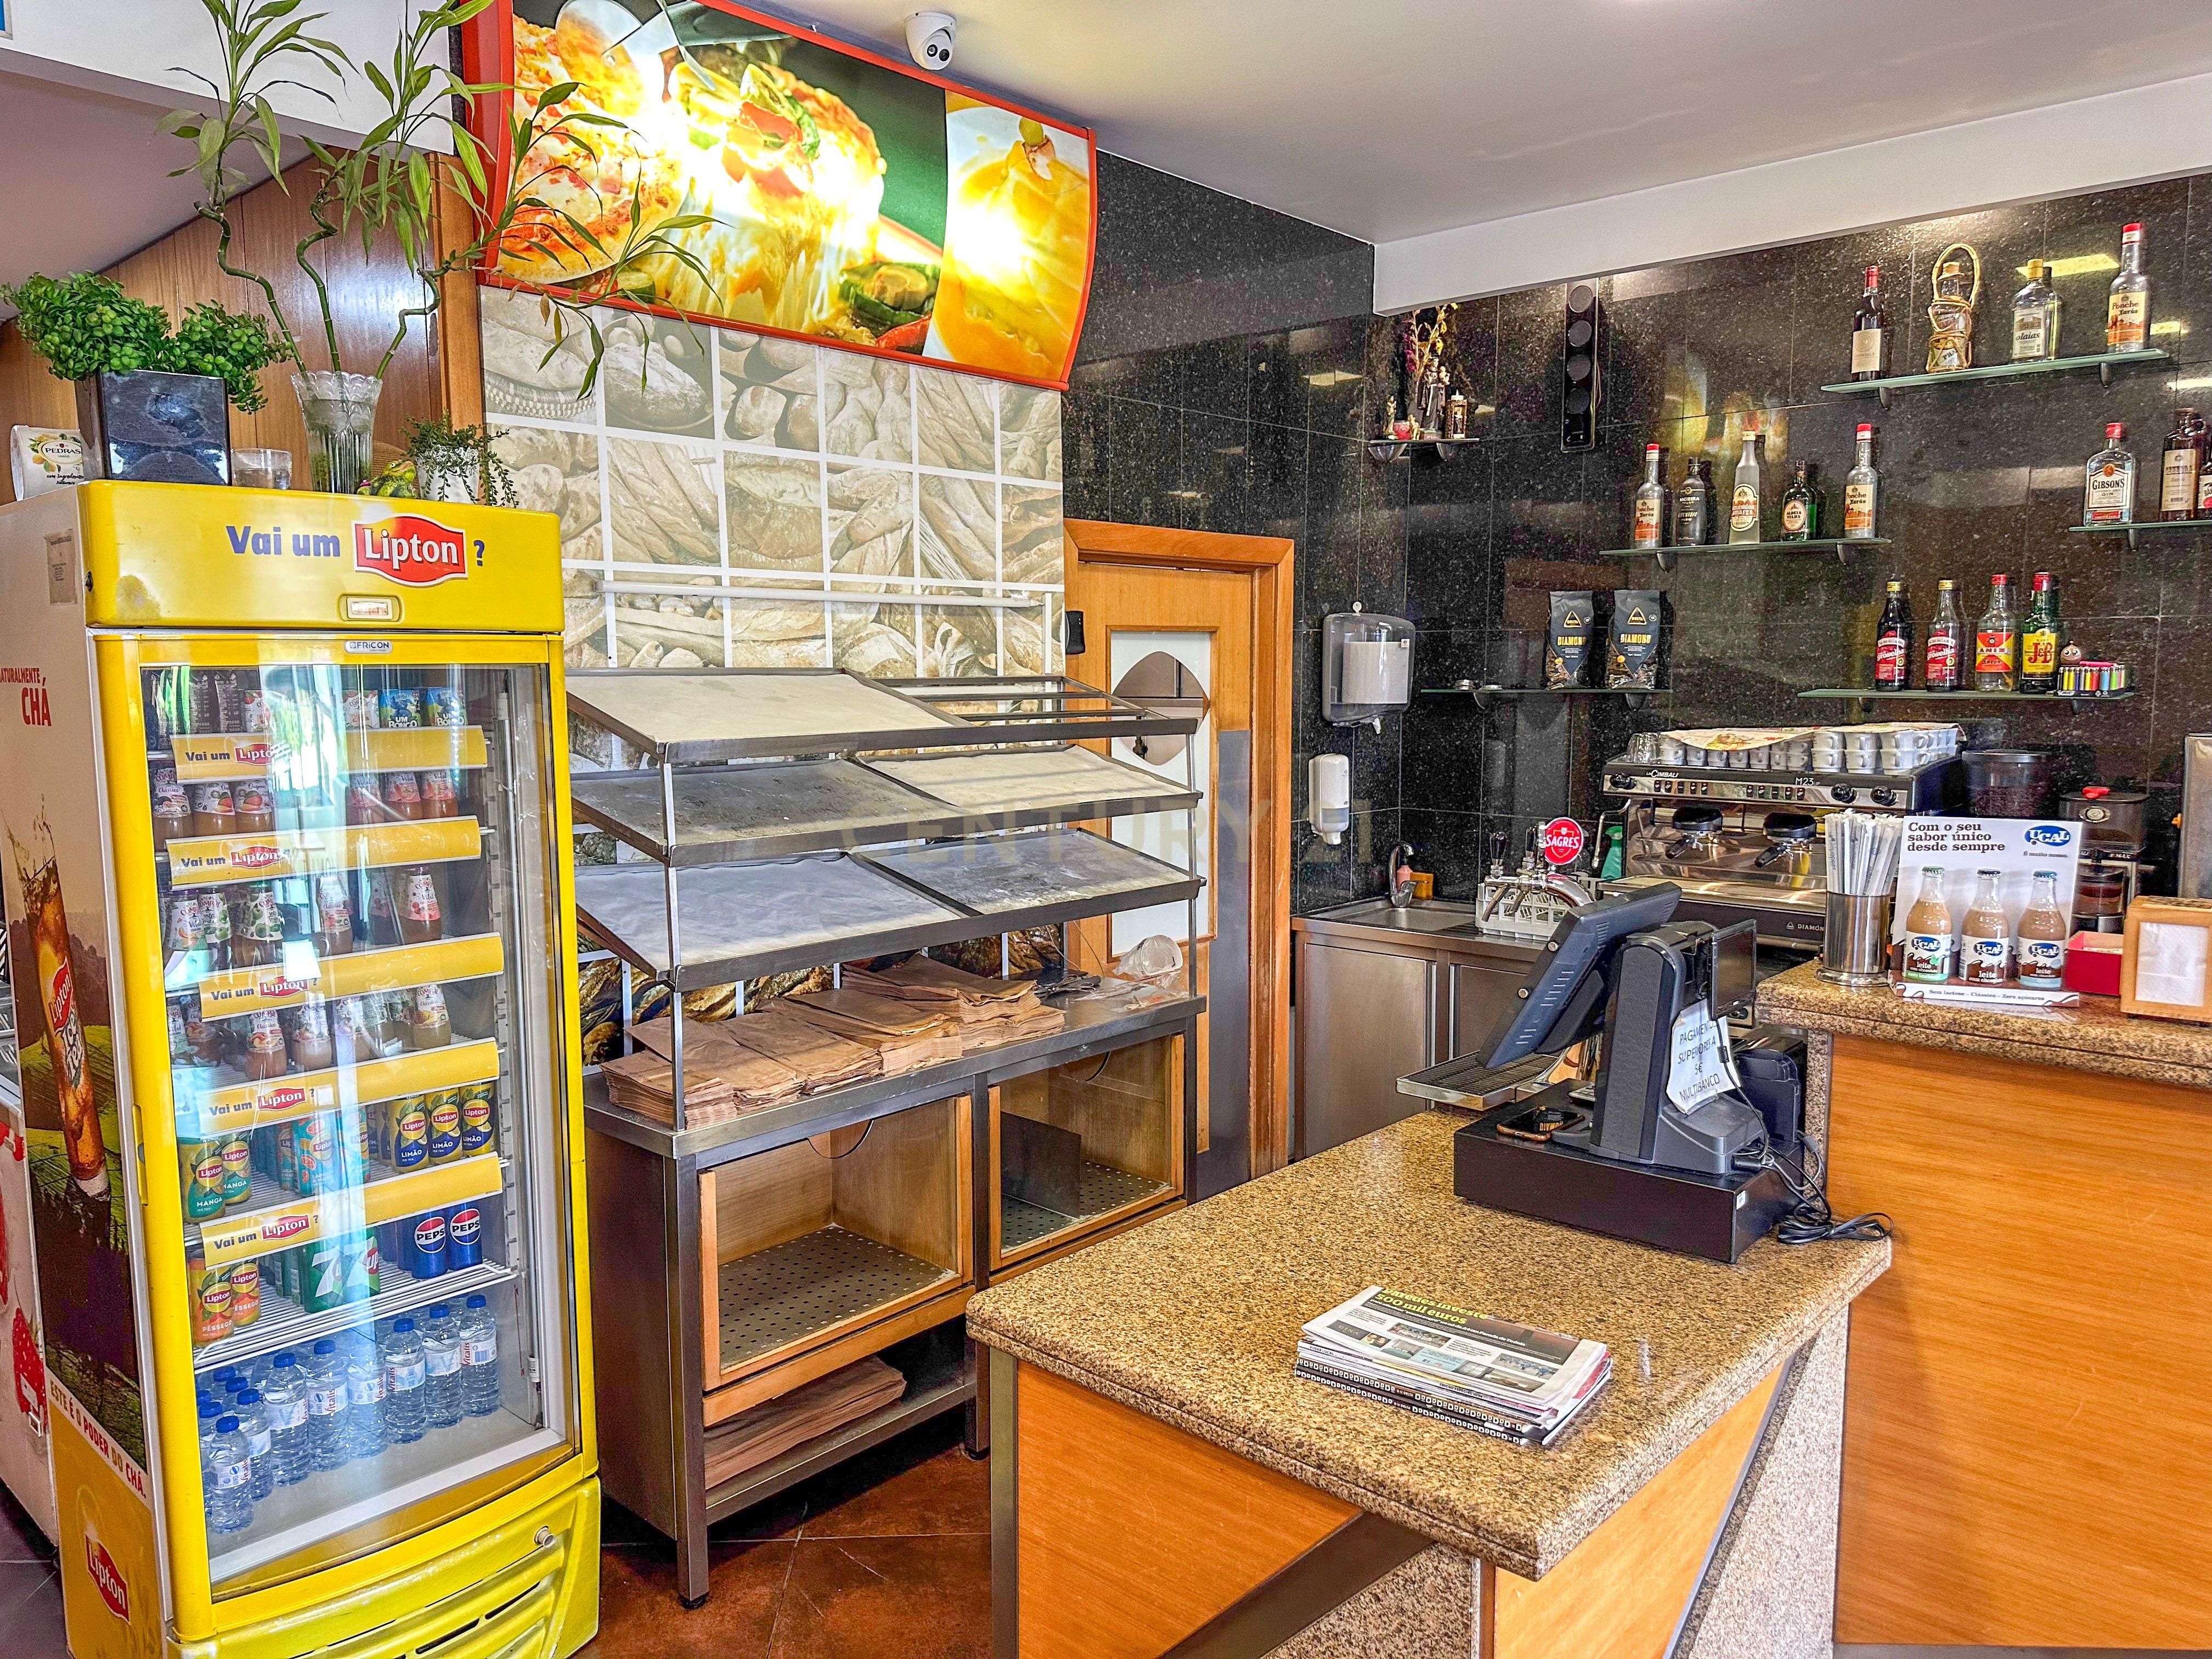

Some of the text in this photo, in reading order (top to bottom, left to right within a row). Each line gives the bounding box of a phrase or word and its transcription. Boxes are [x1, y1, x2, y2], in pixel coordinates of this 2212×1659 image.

[225, 526, 486, 571] Vai um Lipton ?
[1620, 634, 1651, 645] DIAMOND
[0, 668, 41, 684] ATURALMENTE
[21, 677, 52, 726] CHÁ
[185, 749, 274, 761] Vai um Lipto
[1651, 769, 1679, 778] CIMBALI
[1795, 777, 1814, 786] M23
[1908, 822, 1939, 832] Com
[1956, 823, 1982, 831] seu
[1546, 833, 1580, 849] SAGRES
[1908, 831, 1991, 842] sabor único
[2027, 828, 2070, 845] UCAL
[1907, 842, 2005, 853] desde sempre
[181, 851, 279, 867] Vai um Lipton
[1916, 961, 1932, 969] leite
[49, 973, 72, 1023] Lipton
[211, 989, 232, 1001] Vai
[235, 987, 255, 997] um
[263, 980, 305, 995] Lipton
[1678, 1042, 1711, 1064] SUPERIORES
[1679, 1074, 1720, 1102] MULTIBANCO
[209, 1104, 230, 1116] Vai
[234, 1102, 252, 1111] um
[261, 1092, 302, 1107] Lipton
[404, 1121, 425, 1130] Lipton
[435, 1113, 456, 1122] Lipton
[224, 1150, 247, 1161] Lipton
[402, 1149, 422, 1158] LIMÃO
[201, 1166, 222, 1177] Lipton
[196, 1197, 223, 1207] MANGA
[213, 1214, 319, 1250] Vai um Lipton ?
[234, 1272, 257, 1284] Lipton
[207, 1291, 230, 1303] Lipton
[1375, 1293, 1403, 1306] 500
[1402, 1301, 1427, 1313] mil
[1426, 1308, 1468, 1324] euros
[1437, 1302, 1488, 1320] investe
[202, 1319, 233, 1332] PÊSSEGO
[388, 1366, 396, 1392] Vitalis
[324, 1387, 336, 1417] Vitalis
[50, 1378, 68, 1412] ESTE
[83, 1415, 110, 1459] PODER
[111, 1446, 123, 1473] DO
[87, 1544, 127, 1610] Lipton
